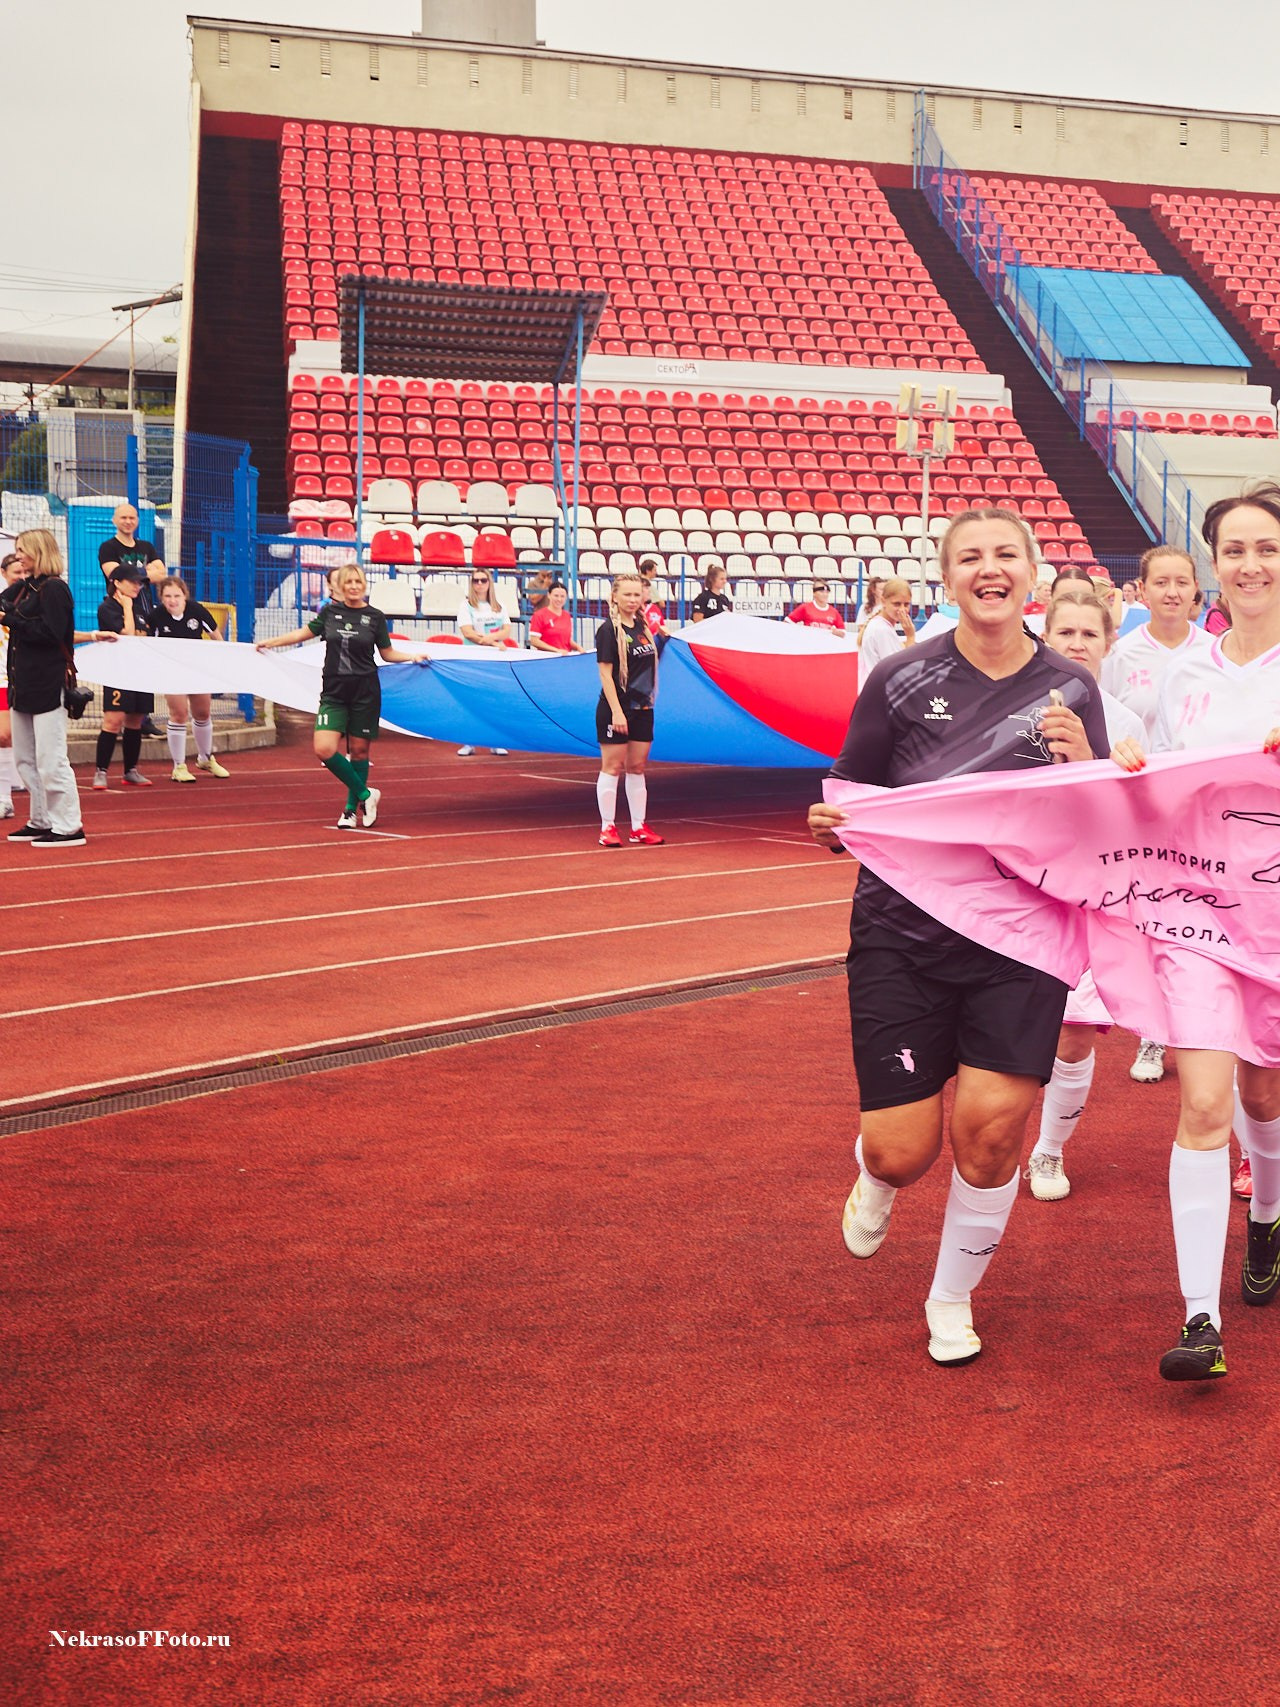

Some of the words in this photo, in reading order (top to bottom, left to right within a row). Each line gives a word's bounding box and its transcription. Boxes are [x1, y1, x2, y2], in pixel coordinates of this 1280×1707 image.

[657, 364, 690, 374] СЕКТОР
[735, 601, 772, 611] СЕКТОР
[112, 690, 121, 706] 2
[1099, 847, 1226, 874] ТЕРРИТОРИЯ
[1135, 920, 1231, 946] УТБОЛА
